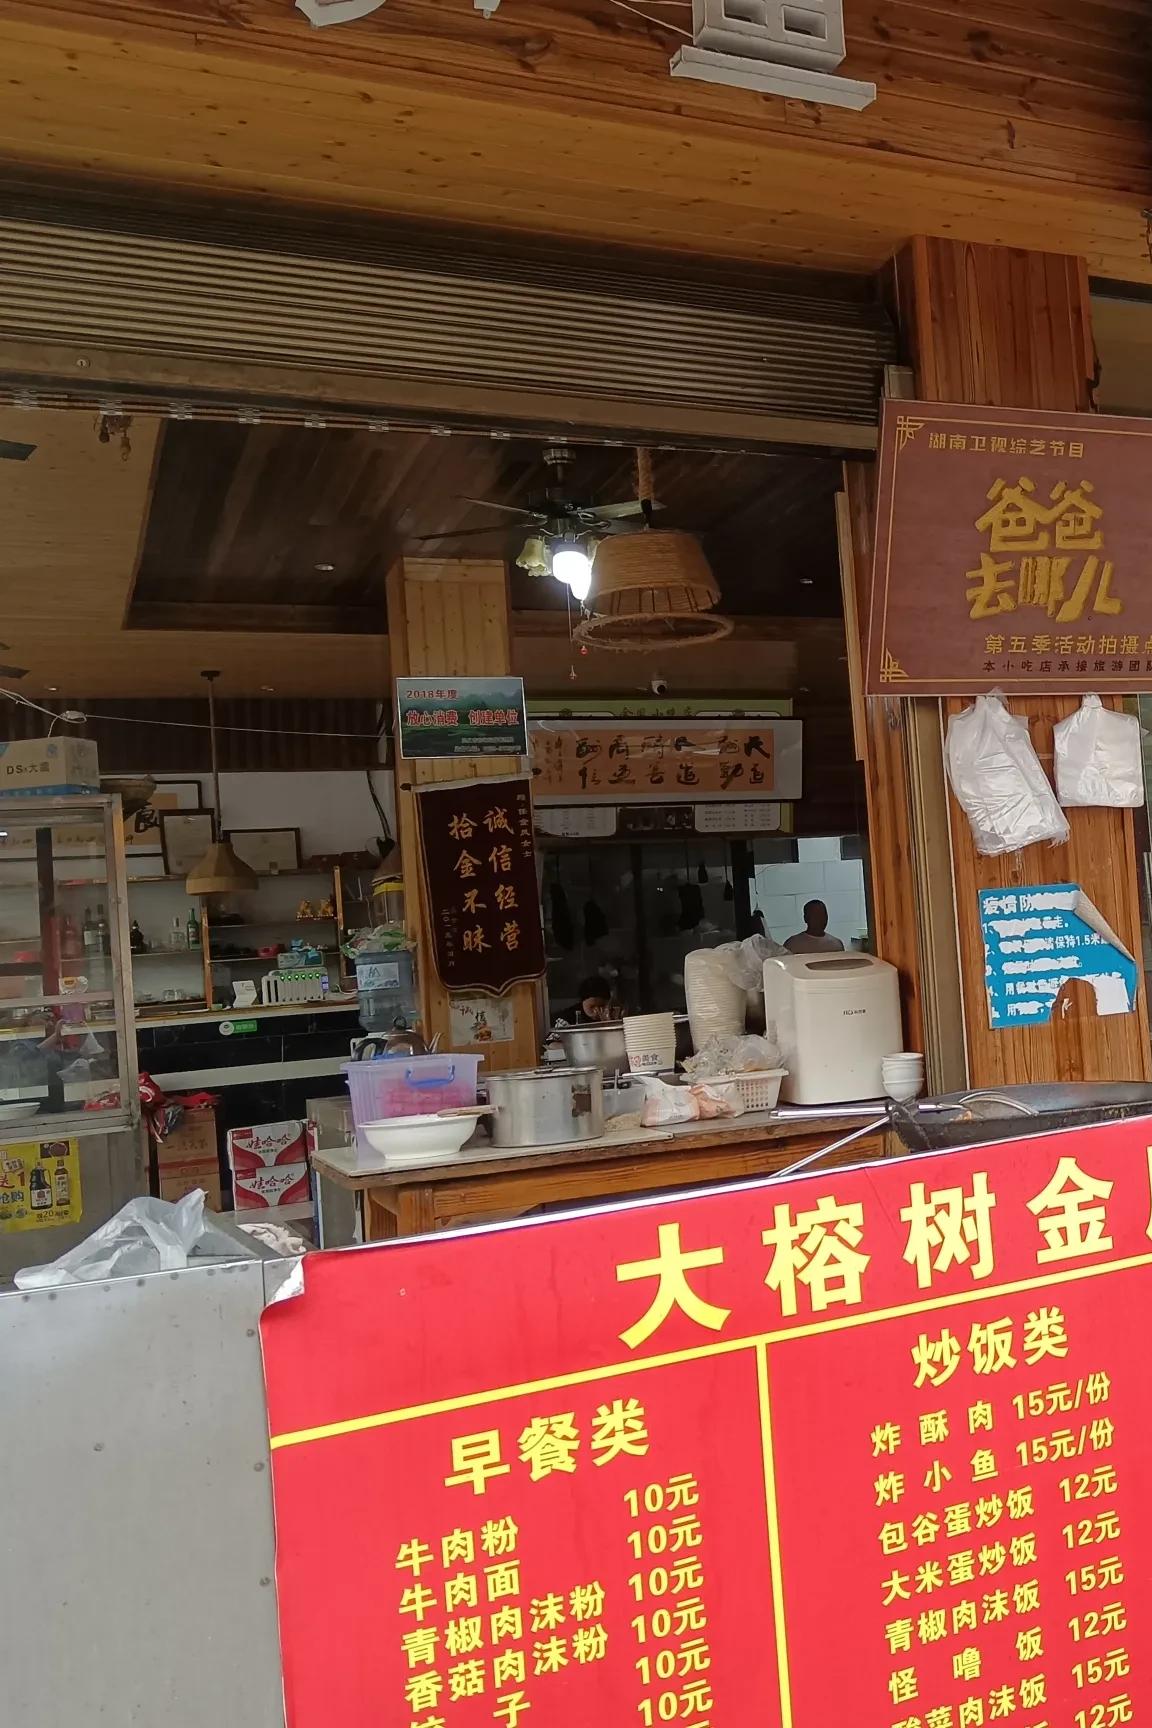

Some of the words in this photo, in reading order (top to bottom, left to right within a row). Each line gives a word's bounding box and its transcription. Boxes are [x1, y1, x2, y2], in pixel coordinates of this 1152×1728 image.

[929, 432, 1085, 458] 湖南卫视综艺节目
[975, 476, 1103, 553] 爸爸
[966, 552, 1123, 623] 去哪儿
[405, 709, 459, 727] 放心消费
[468, 708, 520, 726] 创建单位
[406, 688, 458, 700] 2018年度
[447, 812, 493, 953] 拾金不昧
[482, 805, 522, 952] 诚信经营
[246, 1134, 291, 1150] 娃哈哈
[249, 1173, 294, 1190] 娃哈哈
[910, 1305, 1069, 1389] 炒饭类
[444, 1397, 649, 1496] 早餐类
[870, 1401, 993, 1458] 炸酥肉
[1012, 1371, 1111, 1421] 15元/份
[874, 1449, 999, 1507] 炸小鱼
[1016, 1417, 1114, 1467] 15元/份
[395, 1516, 519, 1577] 牛肉粉
[624, 1473, 699, 1518] 10元
[878, 1486, 1034, 1555] 包谷蛋炒饭
[1059, 1464, 1118, 1503] 12元
[399, 1560, 520, 1622] 牛肉面
[627, 1514, 702, 1559] 10元
[881, 1532, 1037, 1606] 大米蛋炒饭
[1062, 1510, 1121, 1549] 12元
[401, 1581, 605, 1669] 青椒肉沫粉
[628, 1556, 704, 1602] 10元
[885, 1579, 1040, 1655] 青椒肉沫饭
[1065, 1556, 1124, 1596] 15元
[404, 1623, 608, 1713] 香菇肉沫粉
[631, 1597, 707, 1643] 10元
[635, 1638, 711, 1685] 10元
[888, 1626, 1044, 1705] 怪噜饭
[1069, 1602, 1127, 1643] 12元
[1072, 1648, 1130, 1689] 15元
[638, 1679, 713, 1727] 10元
